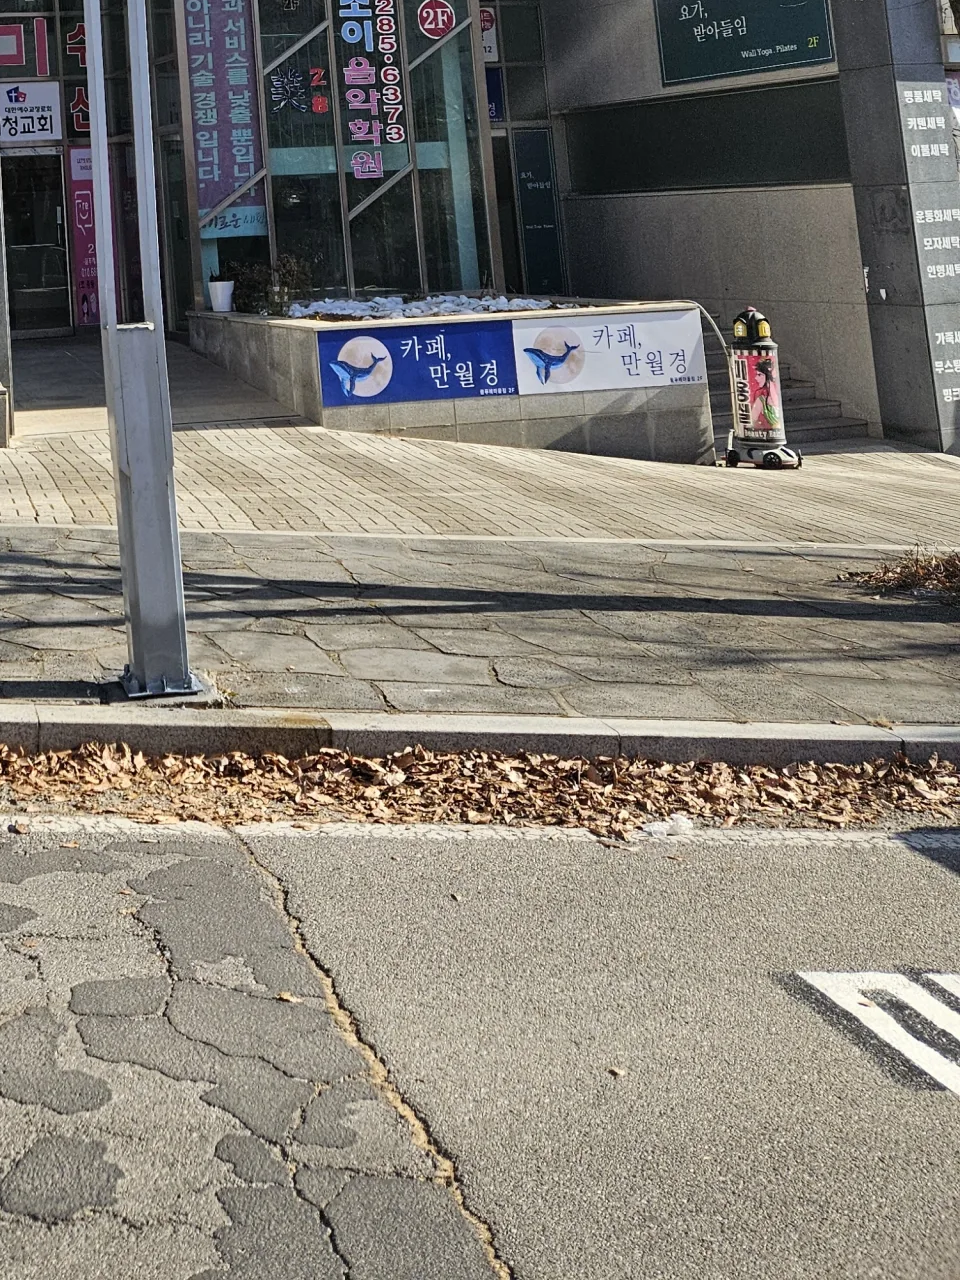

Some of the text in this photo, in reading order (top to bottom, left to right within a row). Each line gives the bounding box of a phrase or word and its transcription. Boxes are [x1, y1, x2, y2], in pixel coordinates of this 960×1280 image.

[423, 8, 451, 29] 2F
[678, 0, 709, 21] 요가,
[693, 16, 748, 42] 받아들임
[223, 19, 250, 86] 서비스를
[741, 49, 757, 59] Wall
[775, 43, 798, 54] Pilates
[807, 36, 820, 49] 2F
[190, 53, 216, 88] 기술
[903, 89, 943, 104] 명품세탁
[342, 56, 385, 180] 음악학원
[911, 143, 950, 158] 이불세탁
[400, 333, 452, 361] 카페,
[429, 358, 499, 389] 만월경
[621, 347, 688, 378] 만월경
